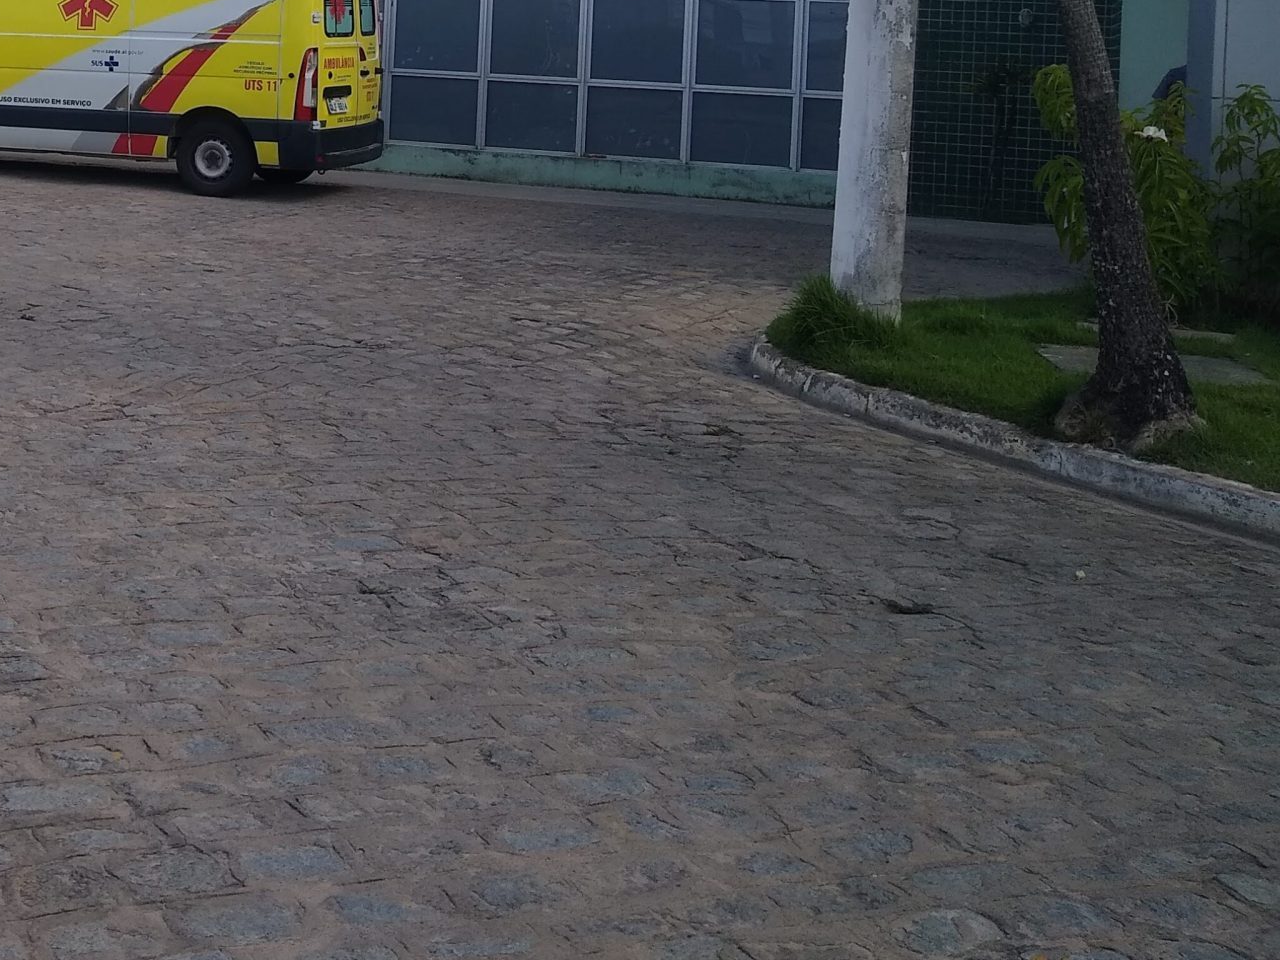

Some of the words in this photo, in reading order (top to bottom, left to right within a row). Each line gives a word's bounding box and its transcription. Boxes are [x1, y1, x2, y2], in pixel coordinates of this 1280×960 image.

[244, 79, 263, 91] UTS
[266, 80, 277, 92] 11
[13, 96, 50, 105] EXCLUSIVO
[62, 99, 92, 107] SERVIÇO
